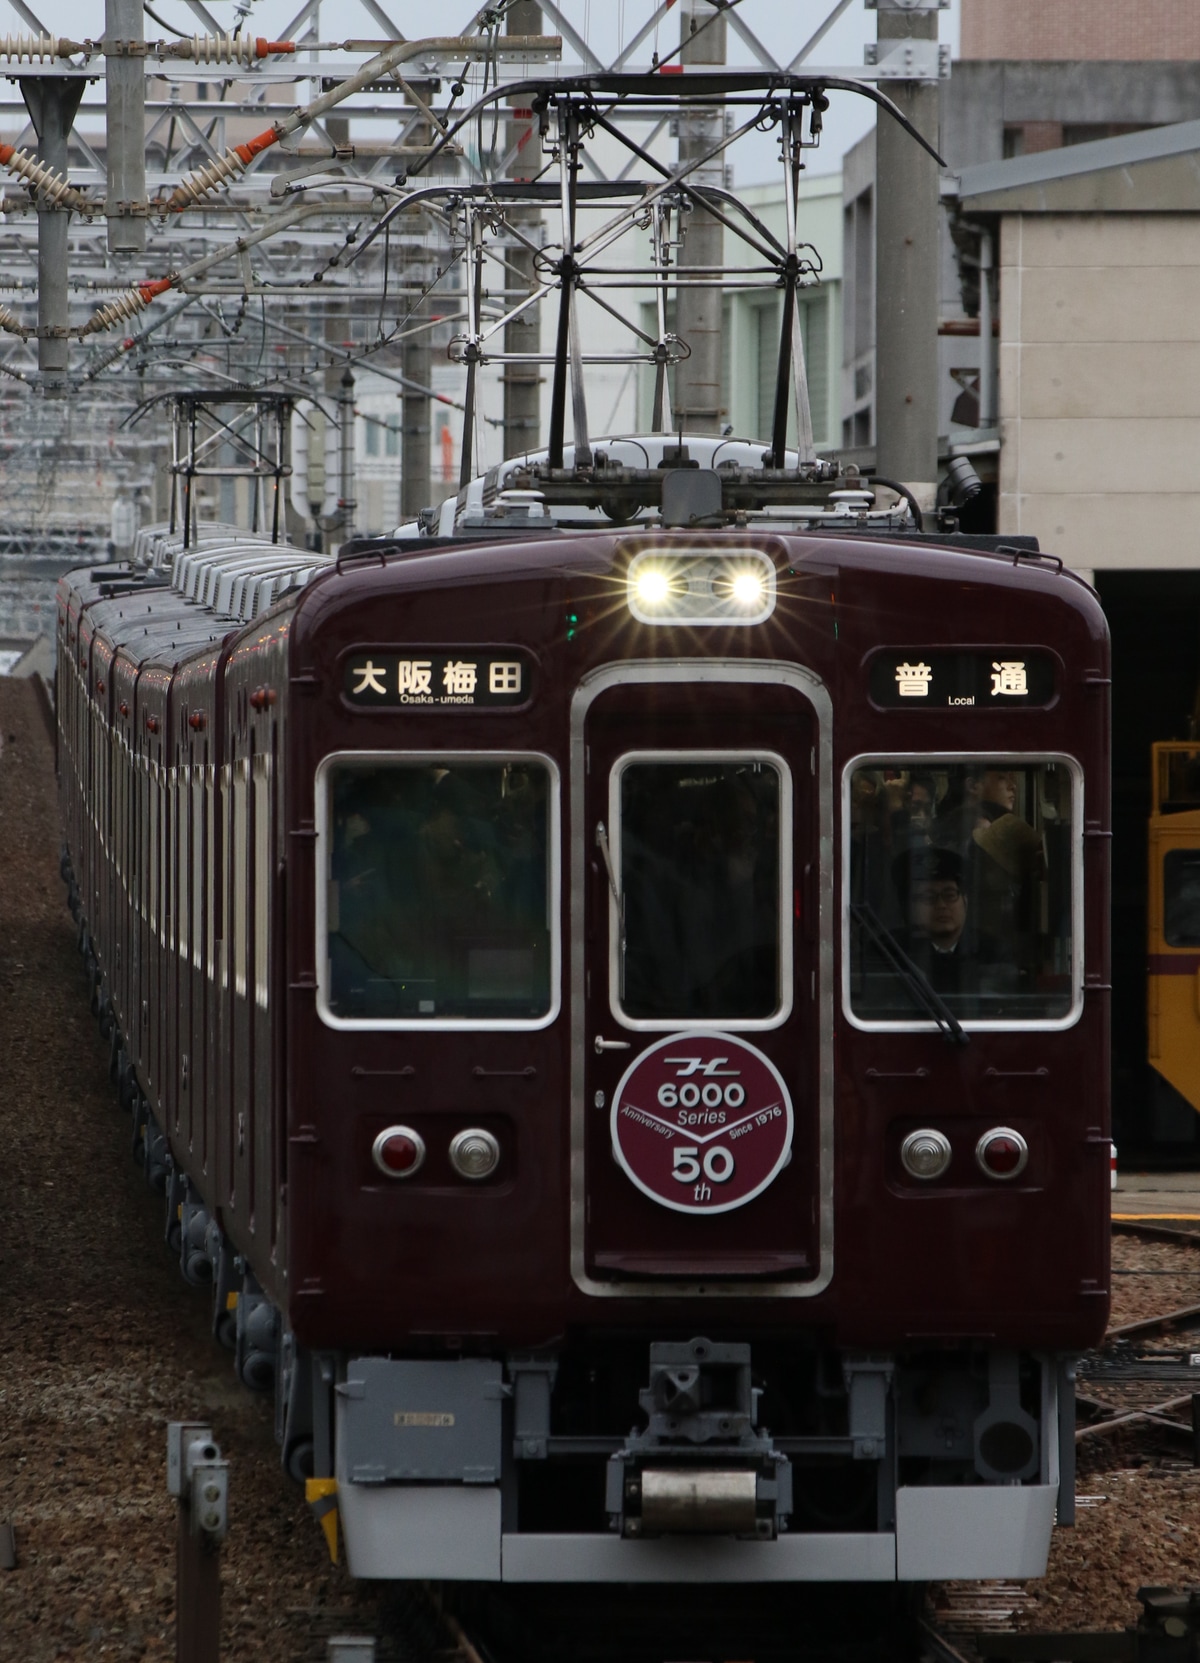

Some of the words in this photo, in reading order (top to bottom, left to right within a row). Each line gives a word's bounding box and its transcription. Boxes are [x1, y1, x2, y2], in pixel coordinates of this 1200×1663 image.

[352, 660, 522, 695] 大阪梅田
[894, 661, 1029, 697] 普通
[400, 694, 474, 705] Osaka-umeda
[948, 696, 975, 706] Local
[657, 1082, 745, 1108] 6000
[620, 1105, 675, 1140] Anniversary
[677, 1108, 726, 1126] Series
[729, 1122, 753, 1140] Since
[755, 1106, 783, 1127] 1976
[671, 1145, 735, 1183] 50
[694, 1182, 712, 1201] th
